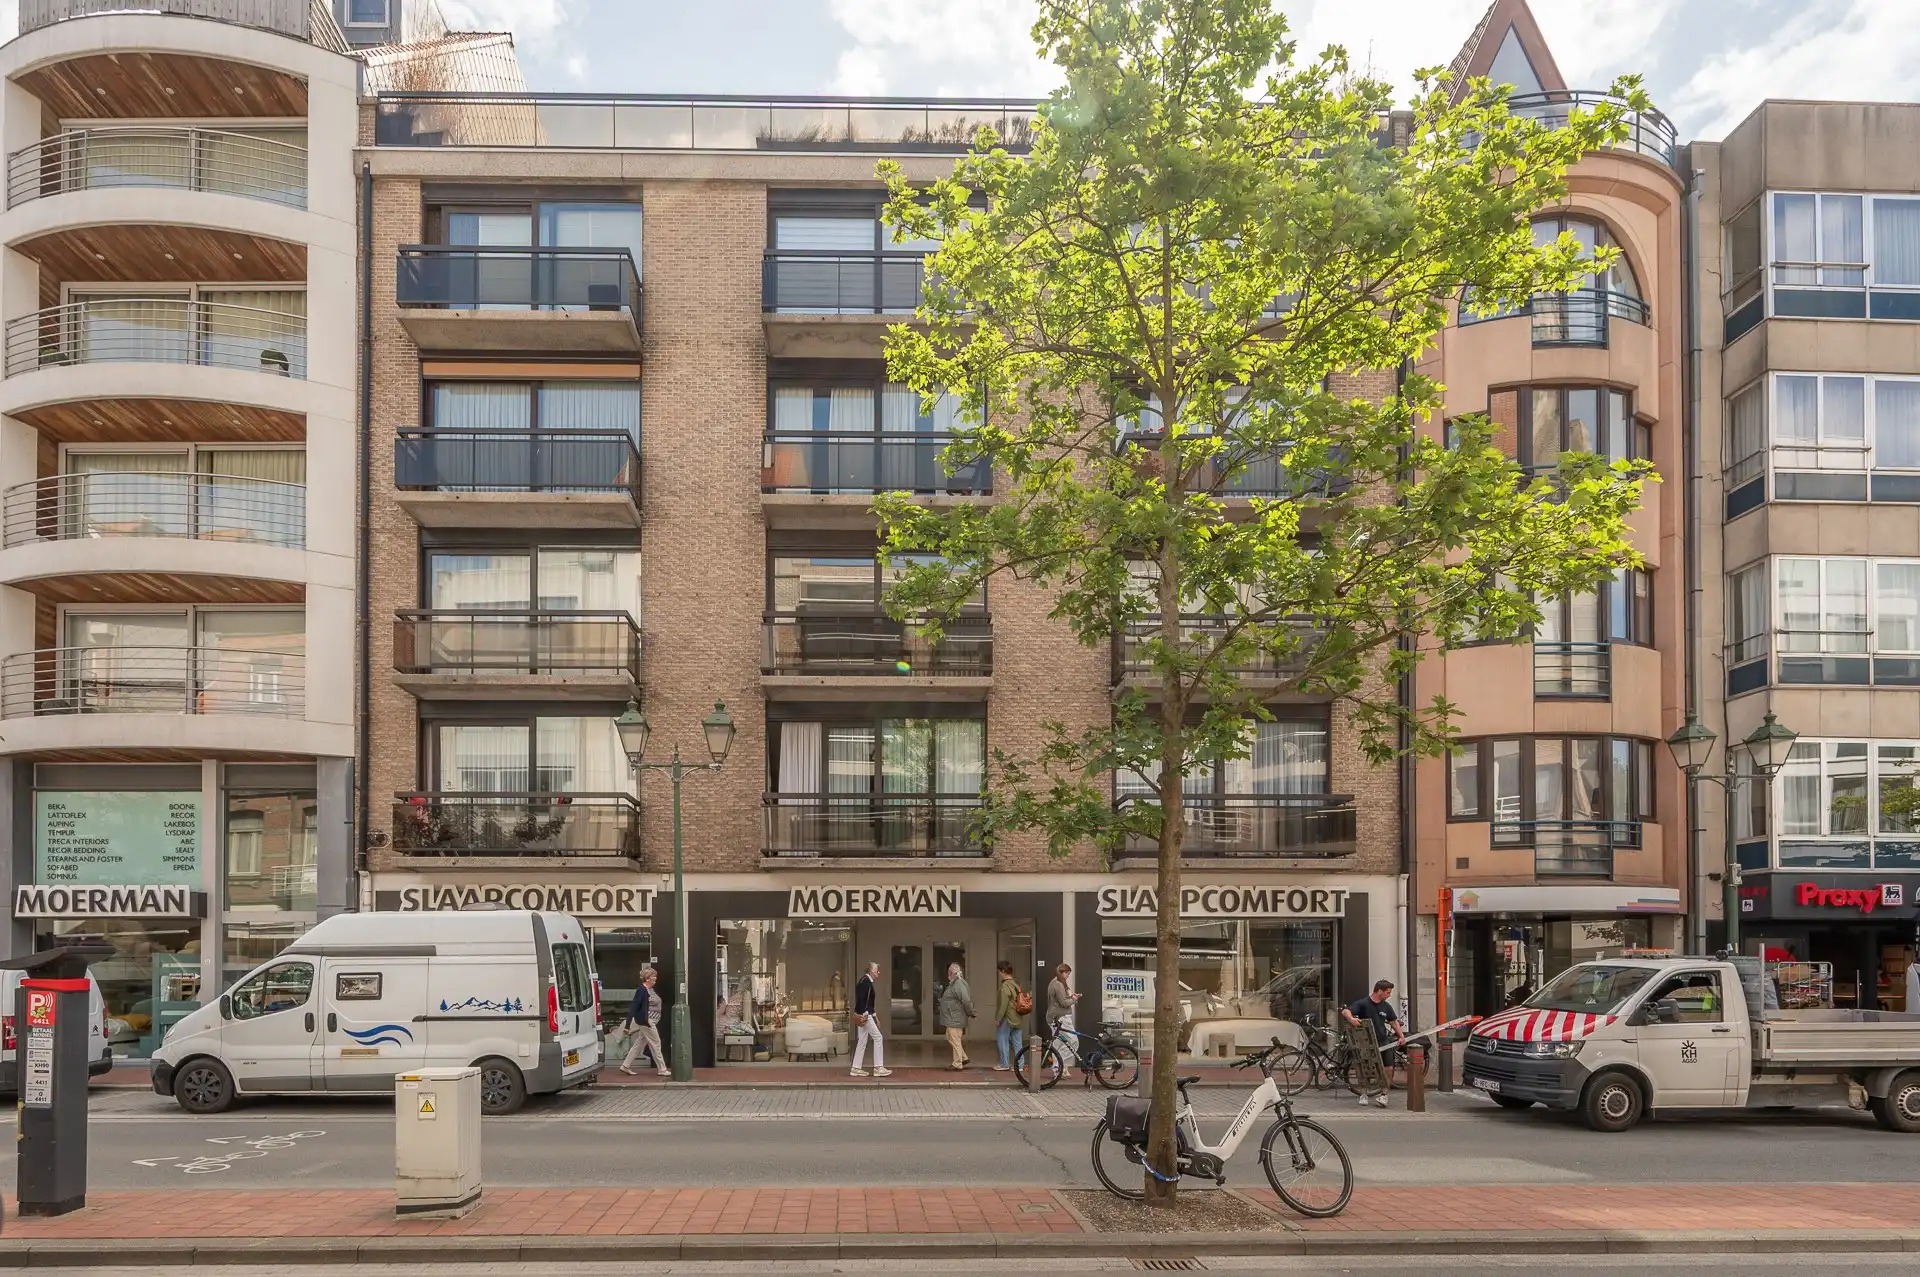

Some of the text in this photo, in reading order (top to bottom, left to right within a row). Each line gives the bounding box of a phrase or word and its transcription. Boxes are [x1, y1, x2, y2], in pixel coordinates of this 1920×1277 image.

[18, 889, 186, 913] MOERMAN
[792, 889, 958, 913] MOERMAN
[1101, 888, 1347, 913] SLAPCOMFORT
[1796, 883, 1881, 913] Proxy
[1681, 1049, 1697, 1059] KH
